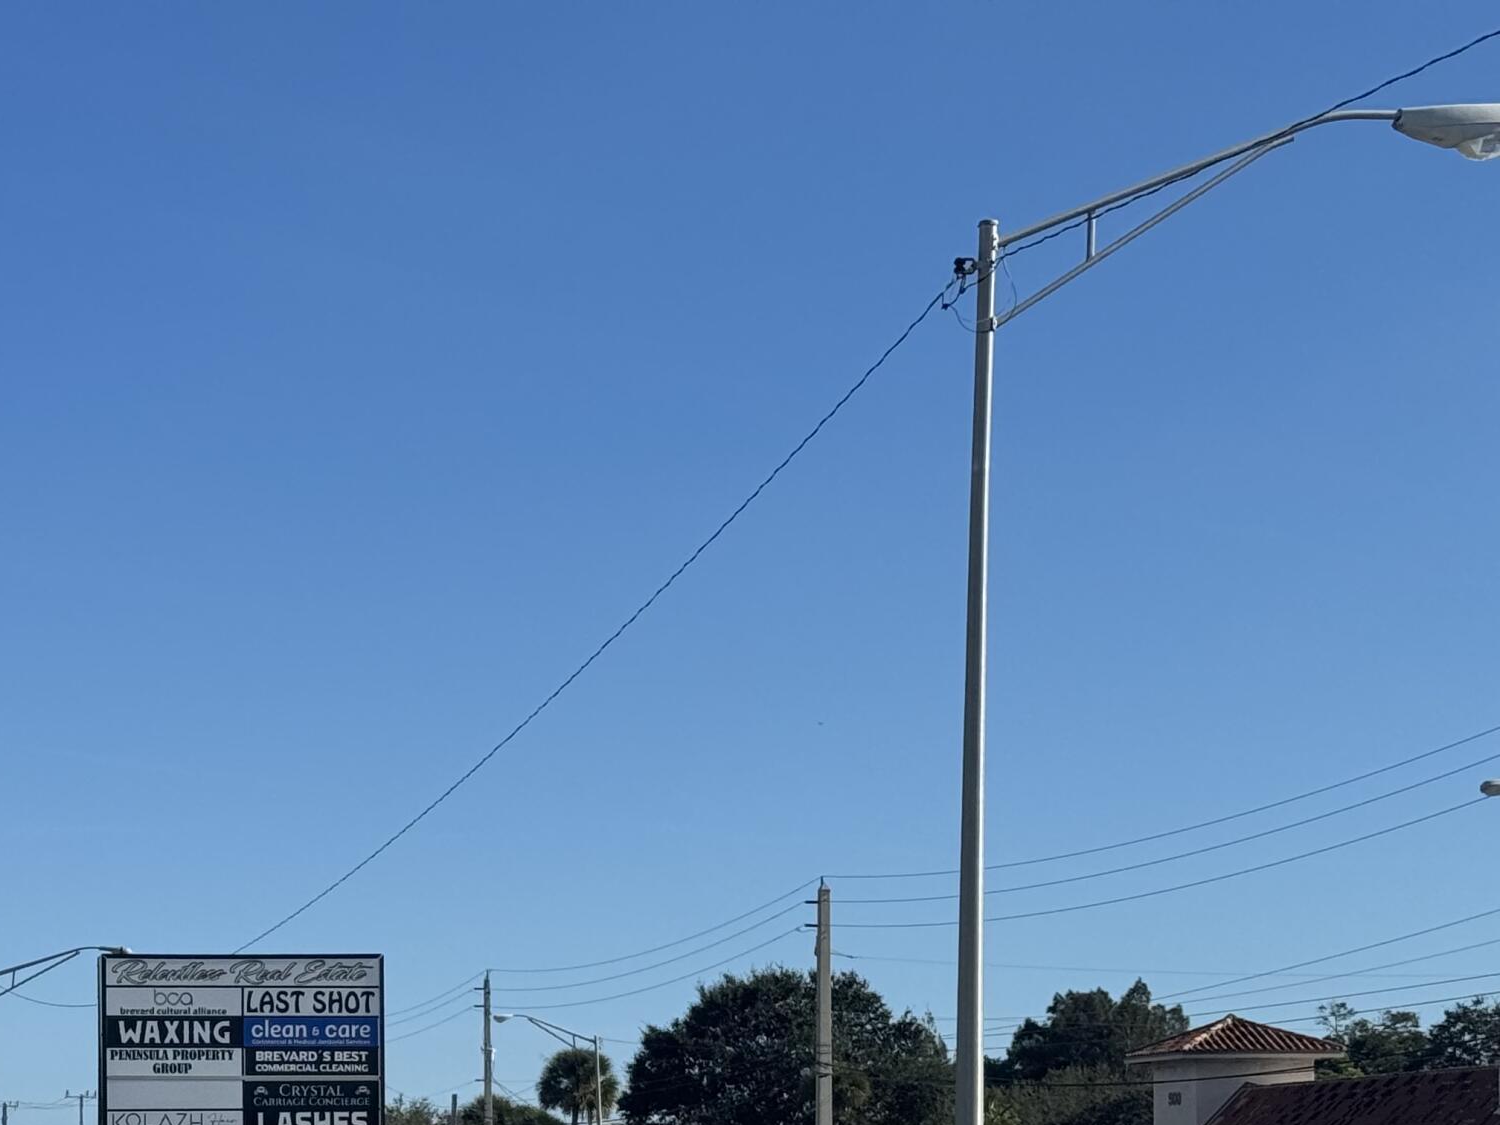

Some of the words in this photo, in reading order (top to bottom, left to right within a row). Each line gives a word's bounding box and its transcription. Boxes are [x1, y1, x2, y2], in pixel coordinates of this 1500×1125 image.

[111, 960, 227, 985] Relentless
[229, 960, 297, 985] Real
[294, 960, 374, 985] Estate
[153, 989, 193, 1006] bca
[246, 990, 305, 1013] LAST
[312, 990, 375, 1014] SHOT
[120, 1007, 155, 1015] brevard
[156, 1007, 191, 1015] cultural
[192, 1007, 227, 1015] alliance
[118, 1020, 231, 1044] WAXING
[251, 1019, 308, 1038] clean
[324, 1024, 371, 1038] care
[110, 1049, 170, 1061] PENINSULA
[172, 1049, 235, 1061] PROPERTY
[334, 1051, 369, 1062] BEST
[152, 1063, 193, 1074] GROUP
[255, 1063, 318, 1072] COMMERCIAL
[319, 1063, 369, 1072] CLEANING
[279, 1083, 345, 1097] CRYSTAL
[253, 1097, 307, 1106] CARRIAGE
[308, 1096, 370, 1106] CONCIERGE
